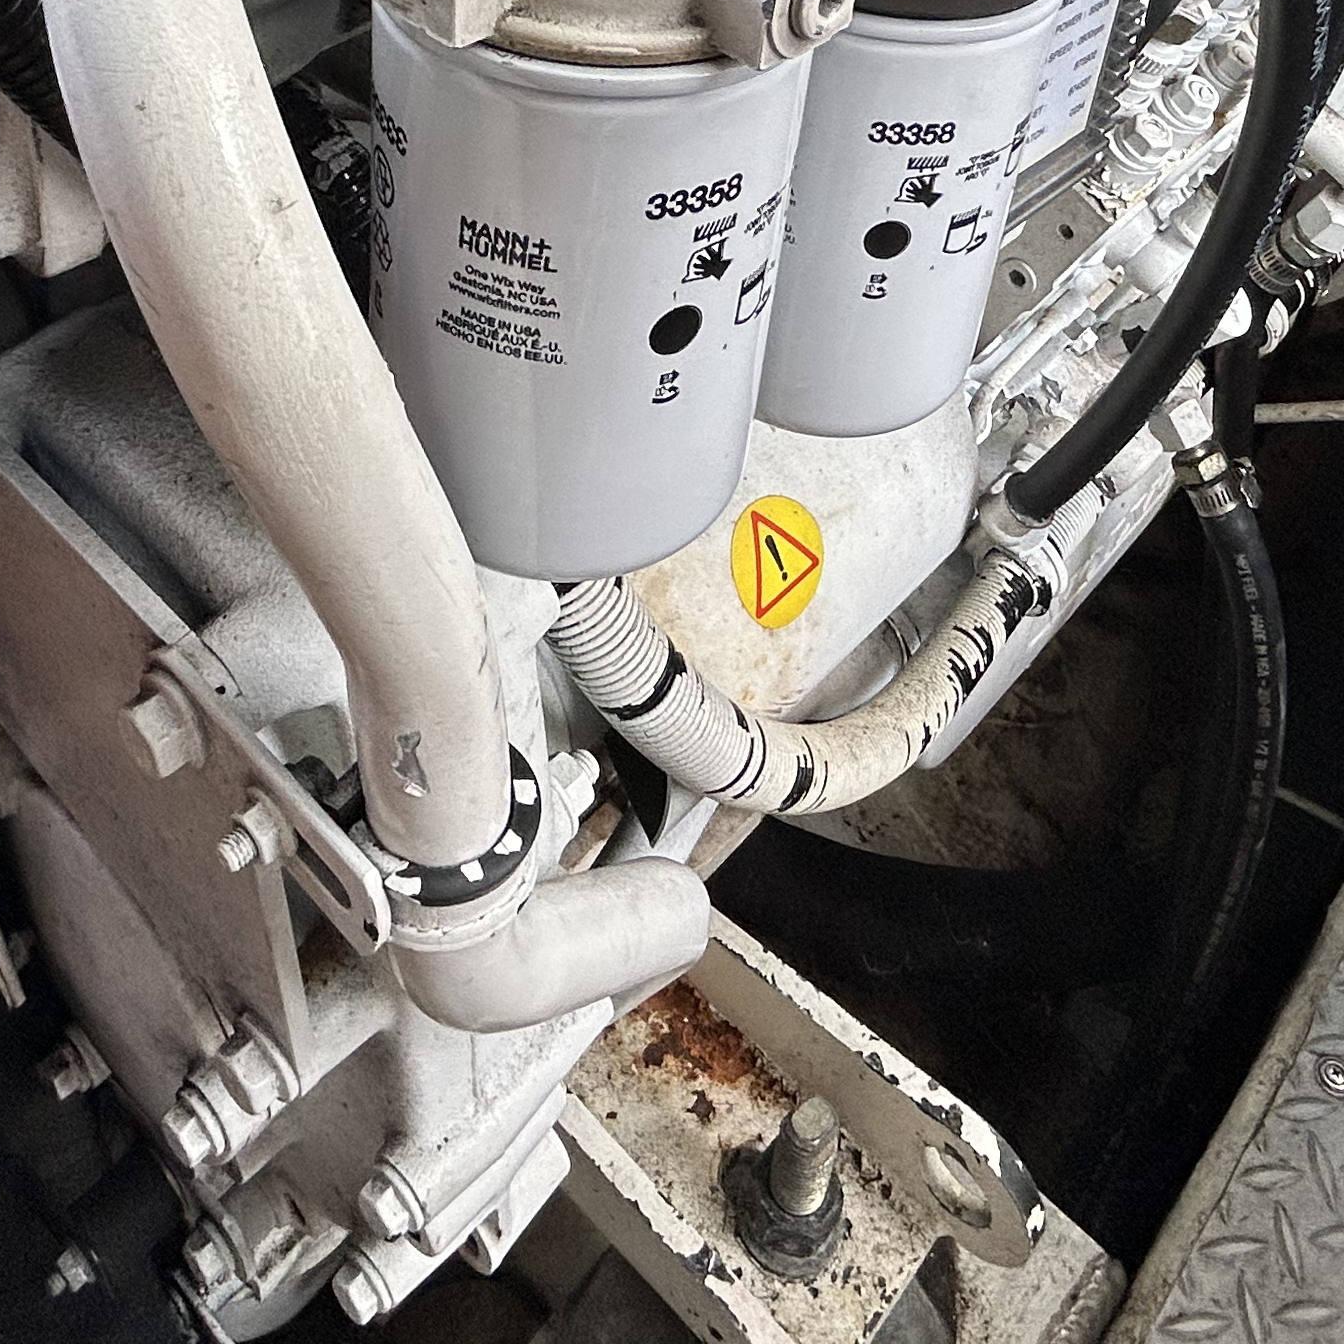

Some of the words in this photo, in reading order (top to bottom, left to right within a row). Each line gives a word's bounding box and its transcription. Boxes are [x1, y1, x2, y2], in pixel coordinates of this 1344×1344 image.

[867, 121, 956, 146] 33358
[645, 173, 744, 220] 33358
[459, 233, 558, 273] HUMMEL
[453, 271, 504, 299] Gastonia,
[506, 289, 527, 303] NC
[529, 293, 558, 308] USA
[465, 264, 489, 281] One
[490, 272, 515, 288] Wix
[517, 280, 546, 295] Way
[448, 281, 561, 320] www.wixfilters.com
[436, 317, 475, 344] HECHO
[476, 337, 494, 352] EN
[495, 343, 522, 359] LOS
[460, 306, 496, 327] MADE
[498, 319, 512, 333] IN
[514, 323, 541, 338] USA
[500, 334, 529, 348] AUX
